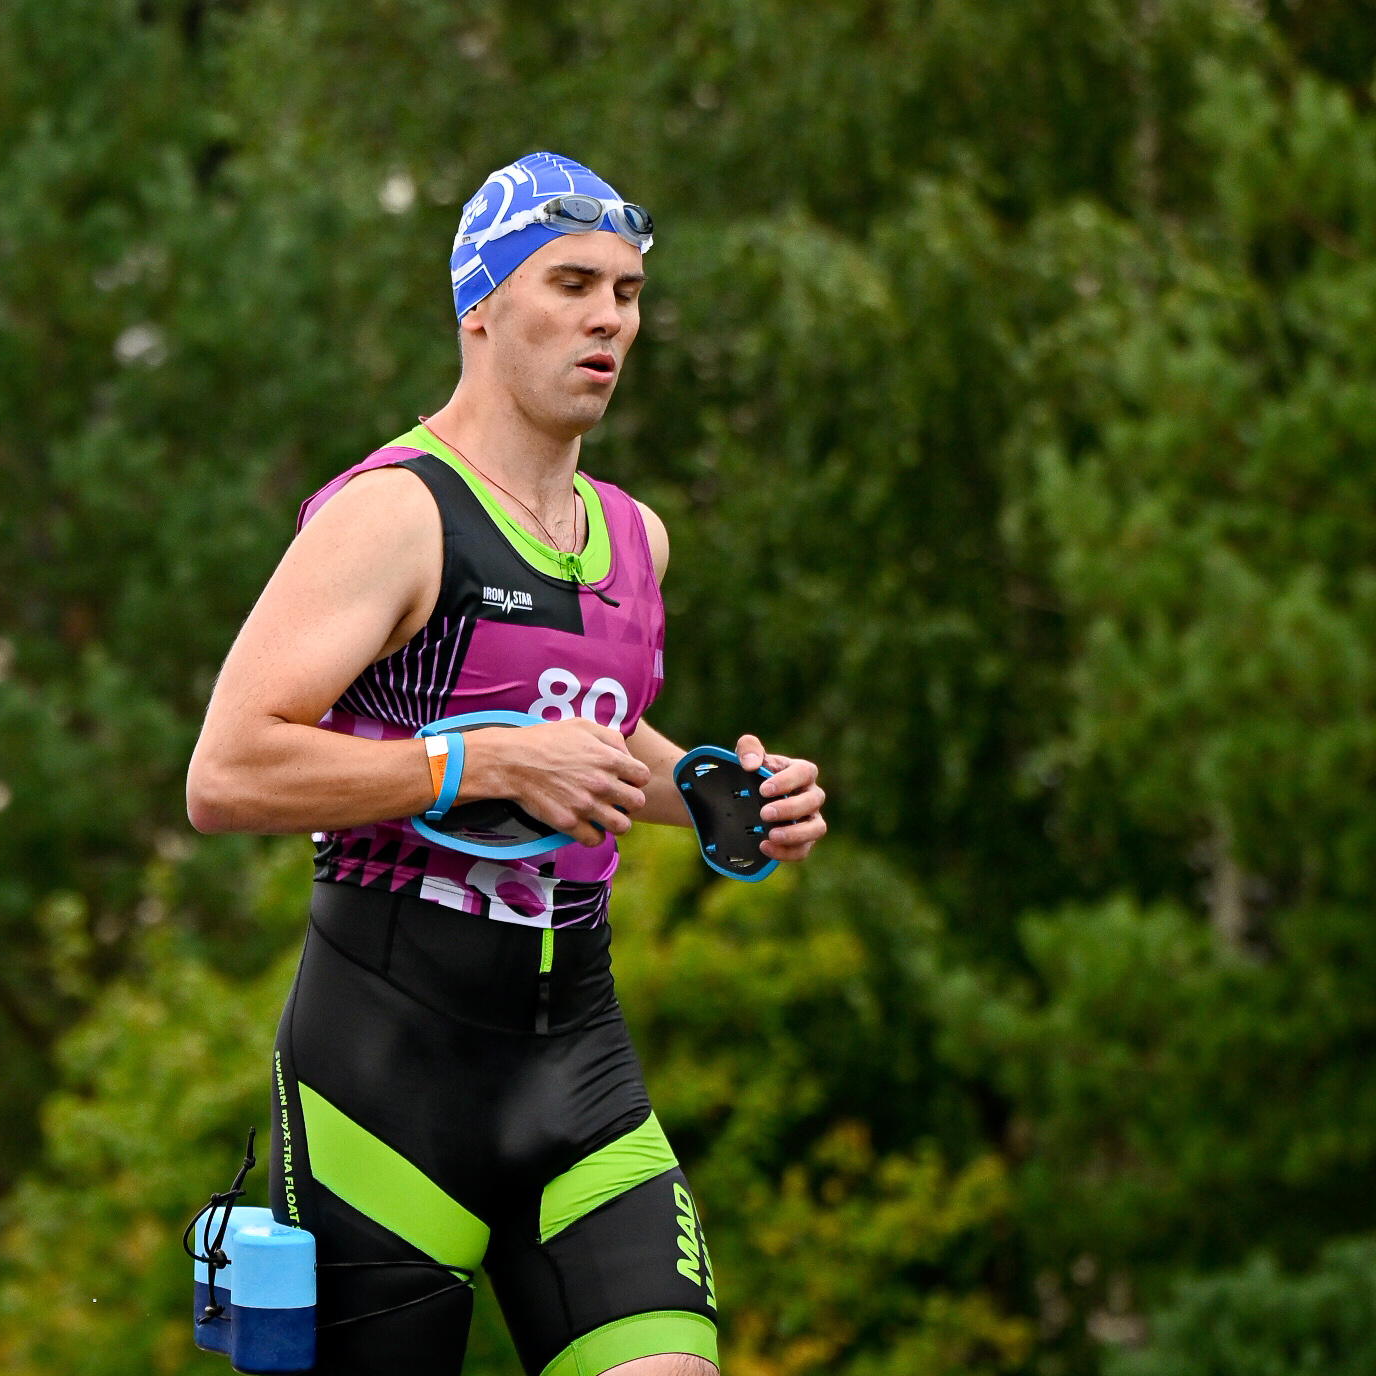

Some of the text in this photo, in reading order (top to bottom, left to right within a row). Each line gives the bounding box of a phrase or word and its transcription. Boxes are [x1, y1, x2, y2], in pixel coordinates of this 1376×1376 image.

[483, 586, 533, 607] IRON STAR
[527, 667, 628, 732] 80
[284, 1176, 301, 1224] FLOAT
[672, 1182, 702, 1287] MAD
